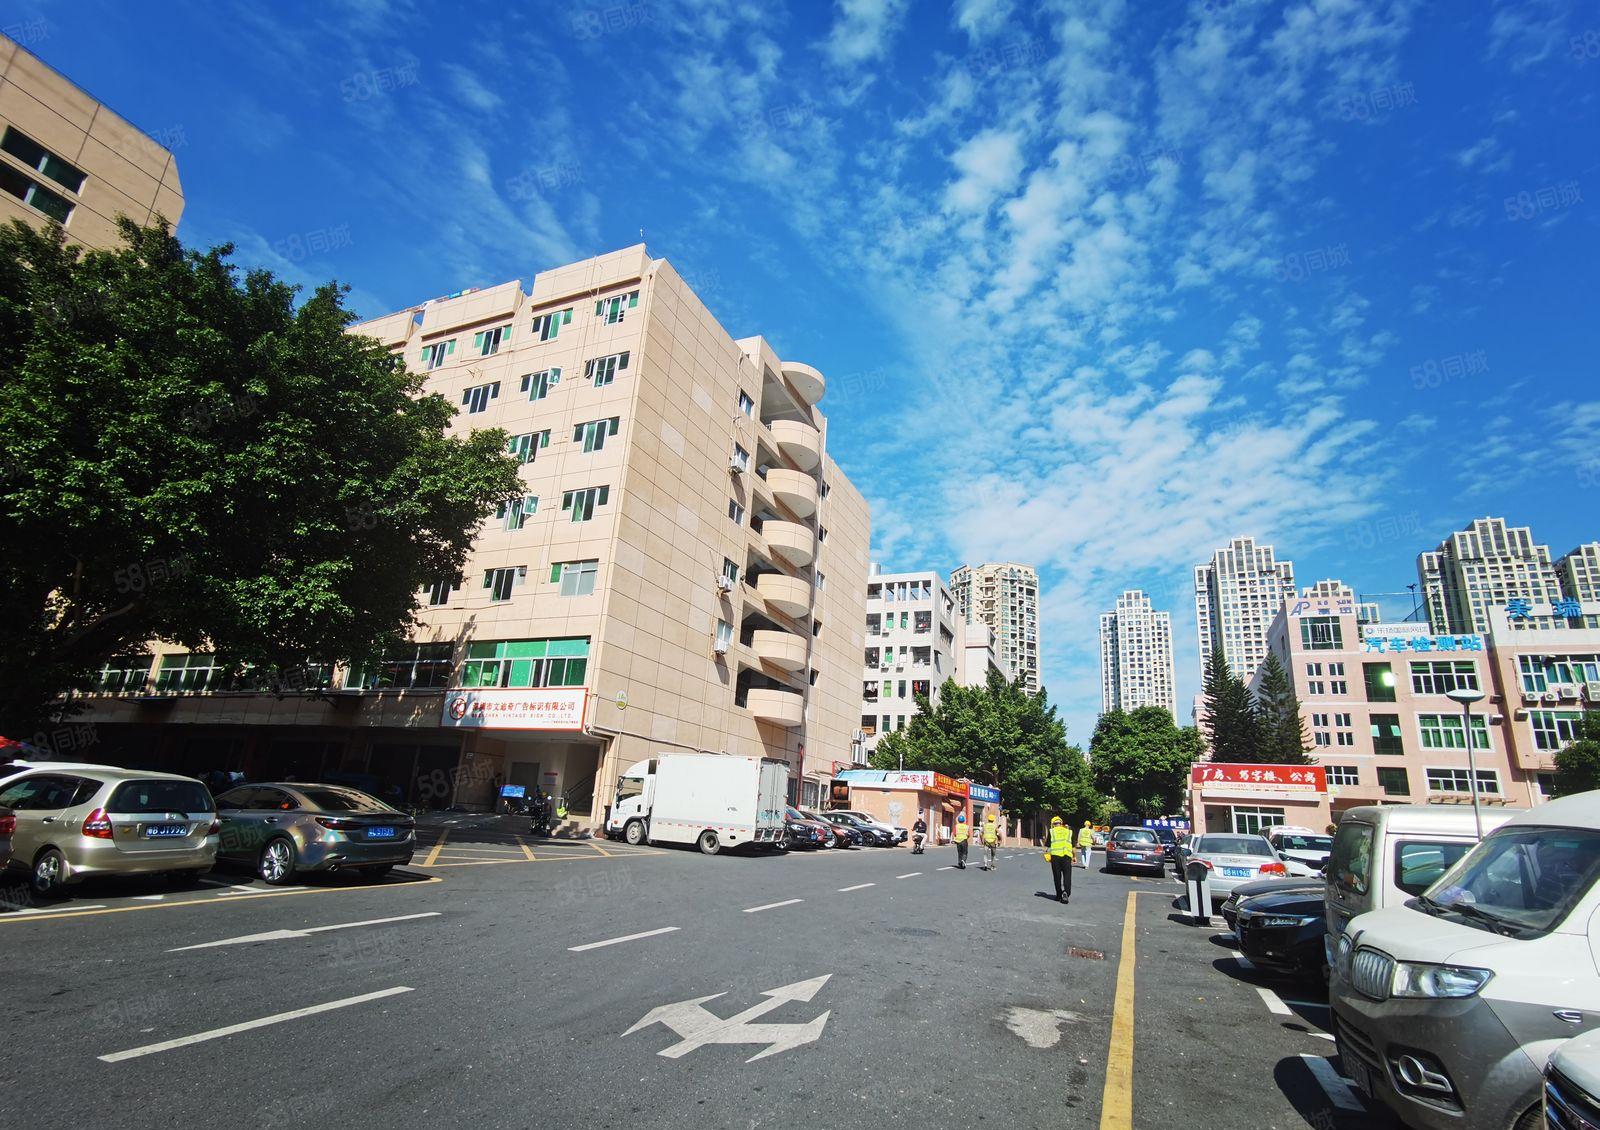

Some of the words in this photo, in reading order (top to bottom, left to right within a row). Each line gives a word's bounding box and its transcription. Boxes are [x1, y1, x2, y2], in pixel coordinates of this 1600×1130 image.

[1505, 597, 1581, 620] 美瑞
[1365, 635, 1483, 654] 汽车检测站
[1202, 768, 1316, 783] 厂房、写字楼、公寓
